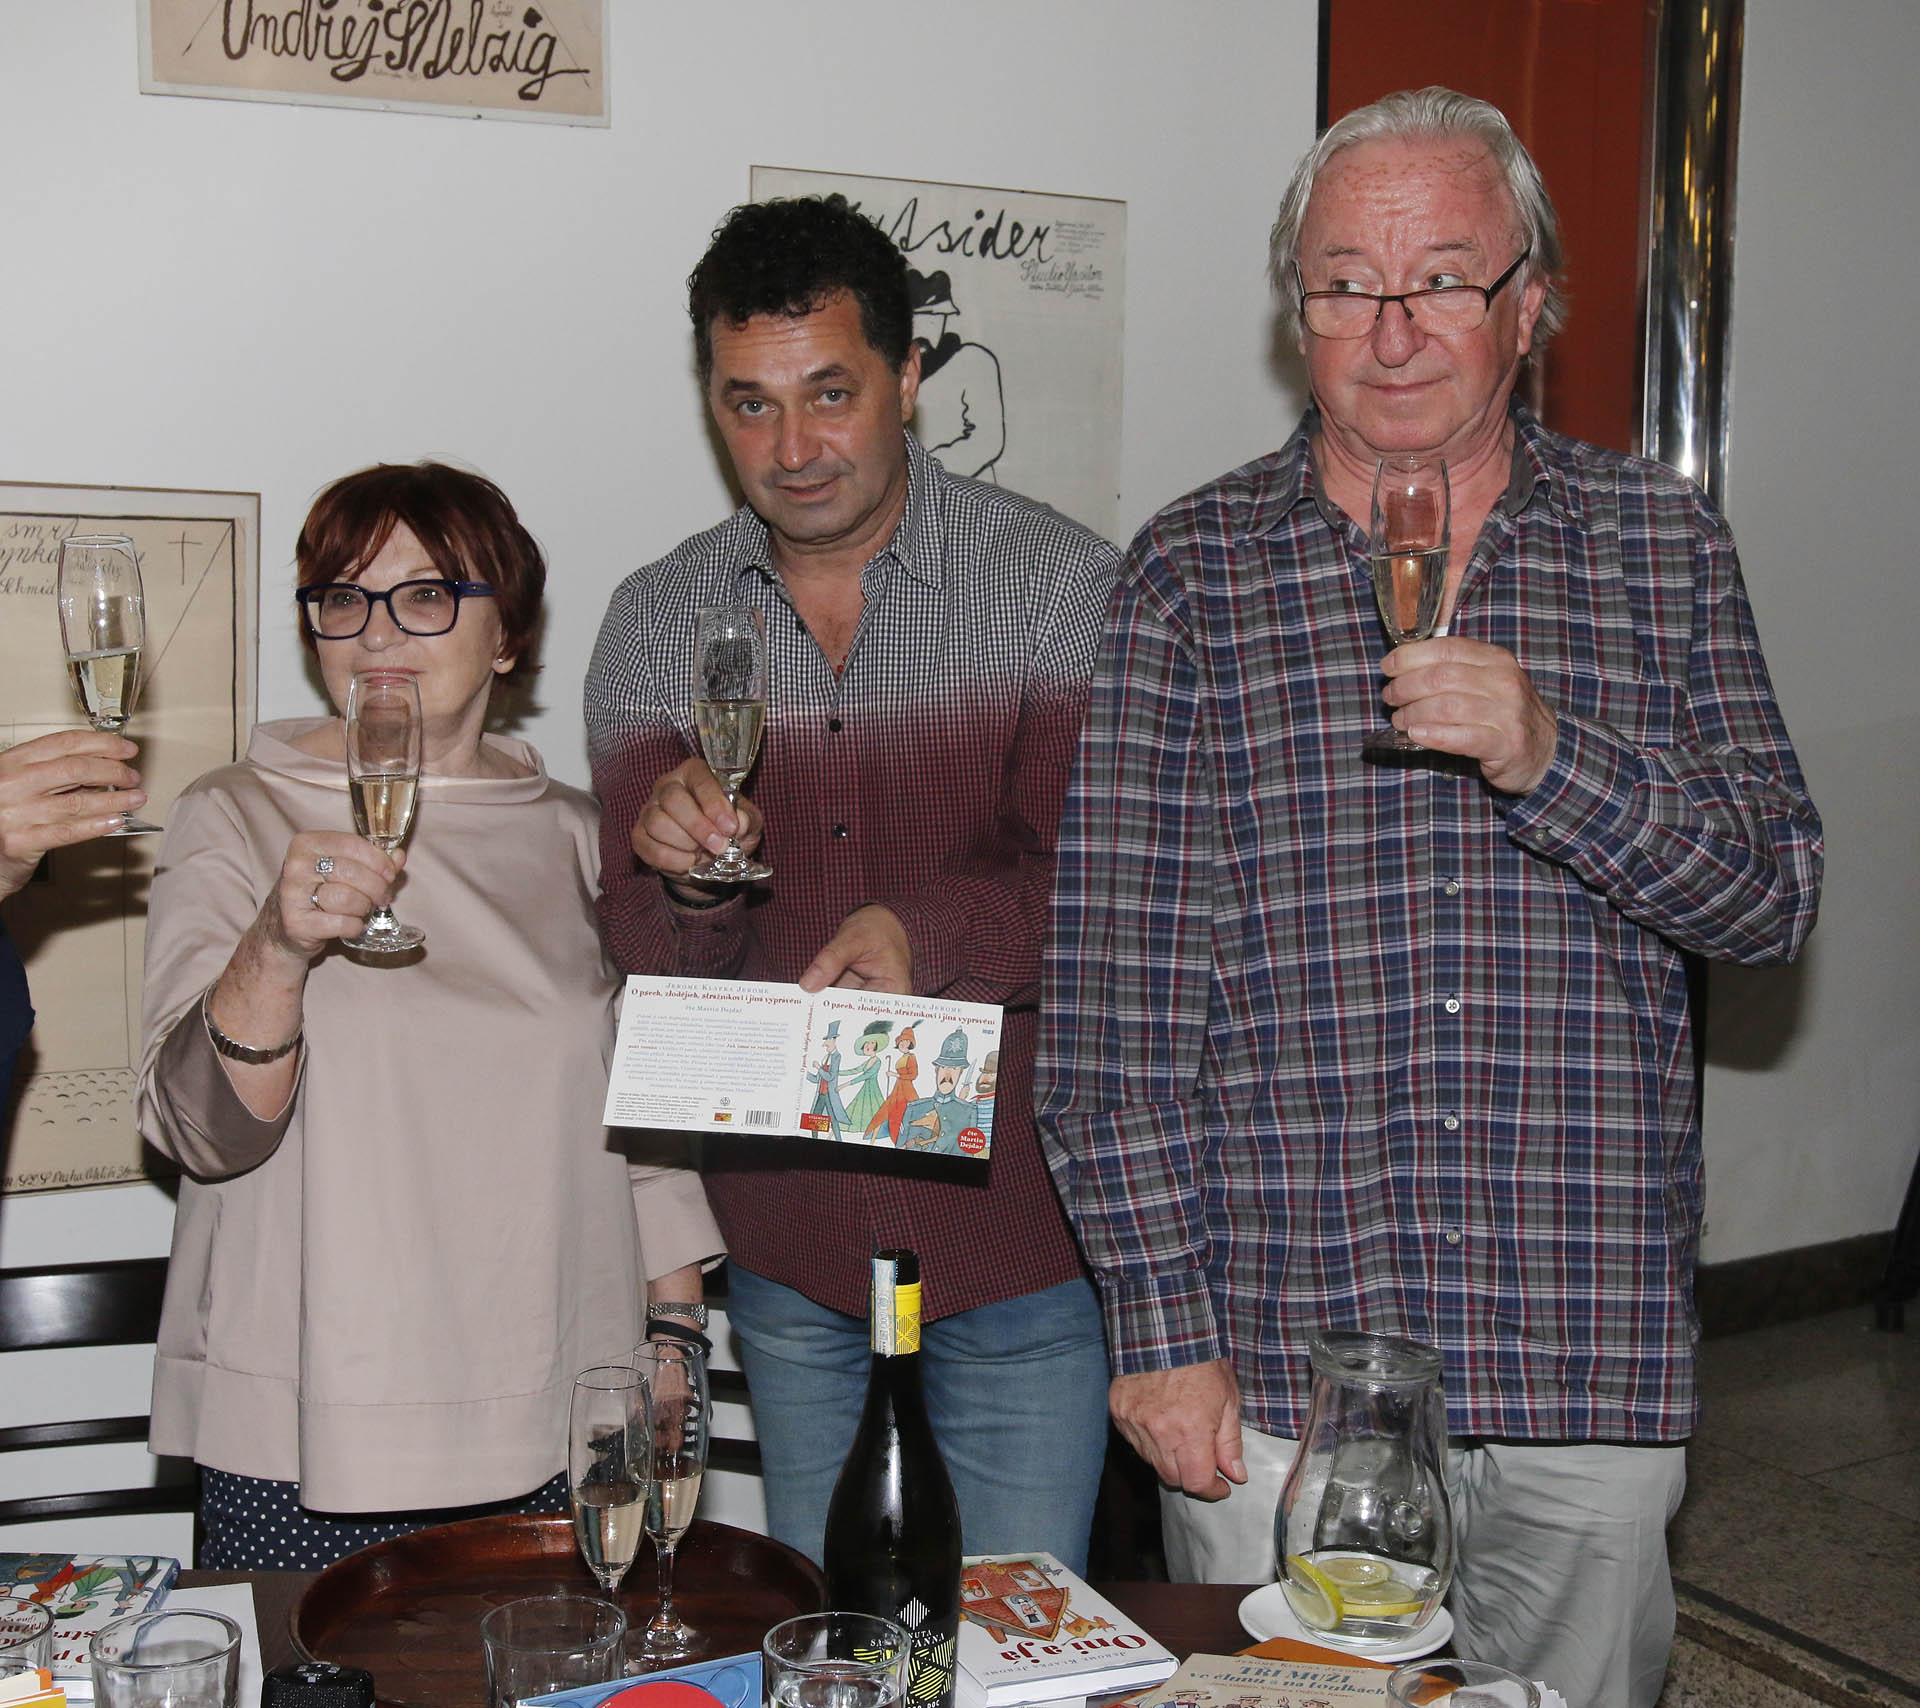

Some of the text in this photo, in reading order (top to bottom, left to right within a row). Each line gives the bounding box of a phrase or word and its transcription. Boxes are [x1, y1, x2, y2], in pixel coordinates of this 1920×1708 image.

[999, 1634, 1147, 1665] Oni a já
